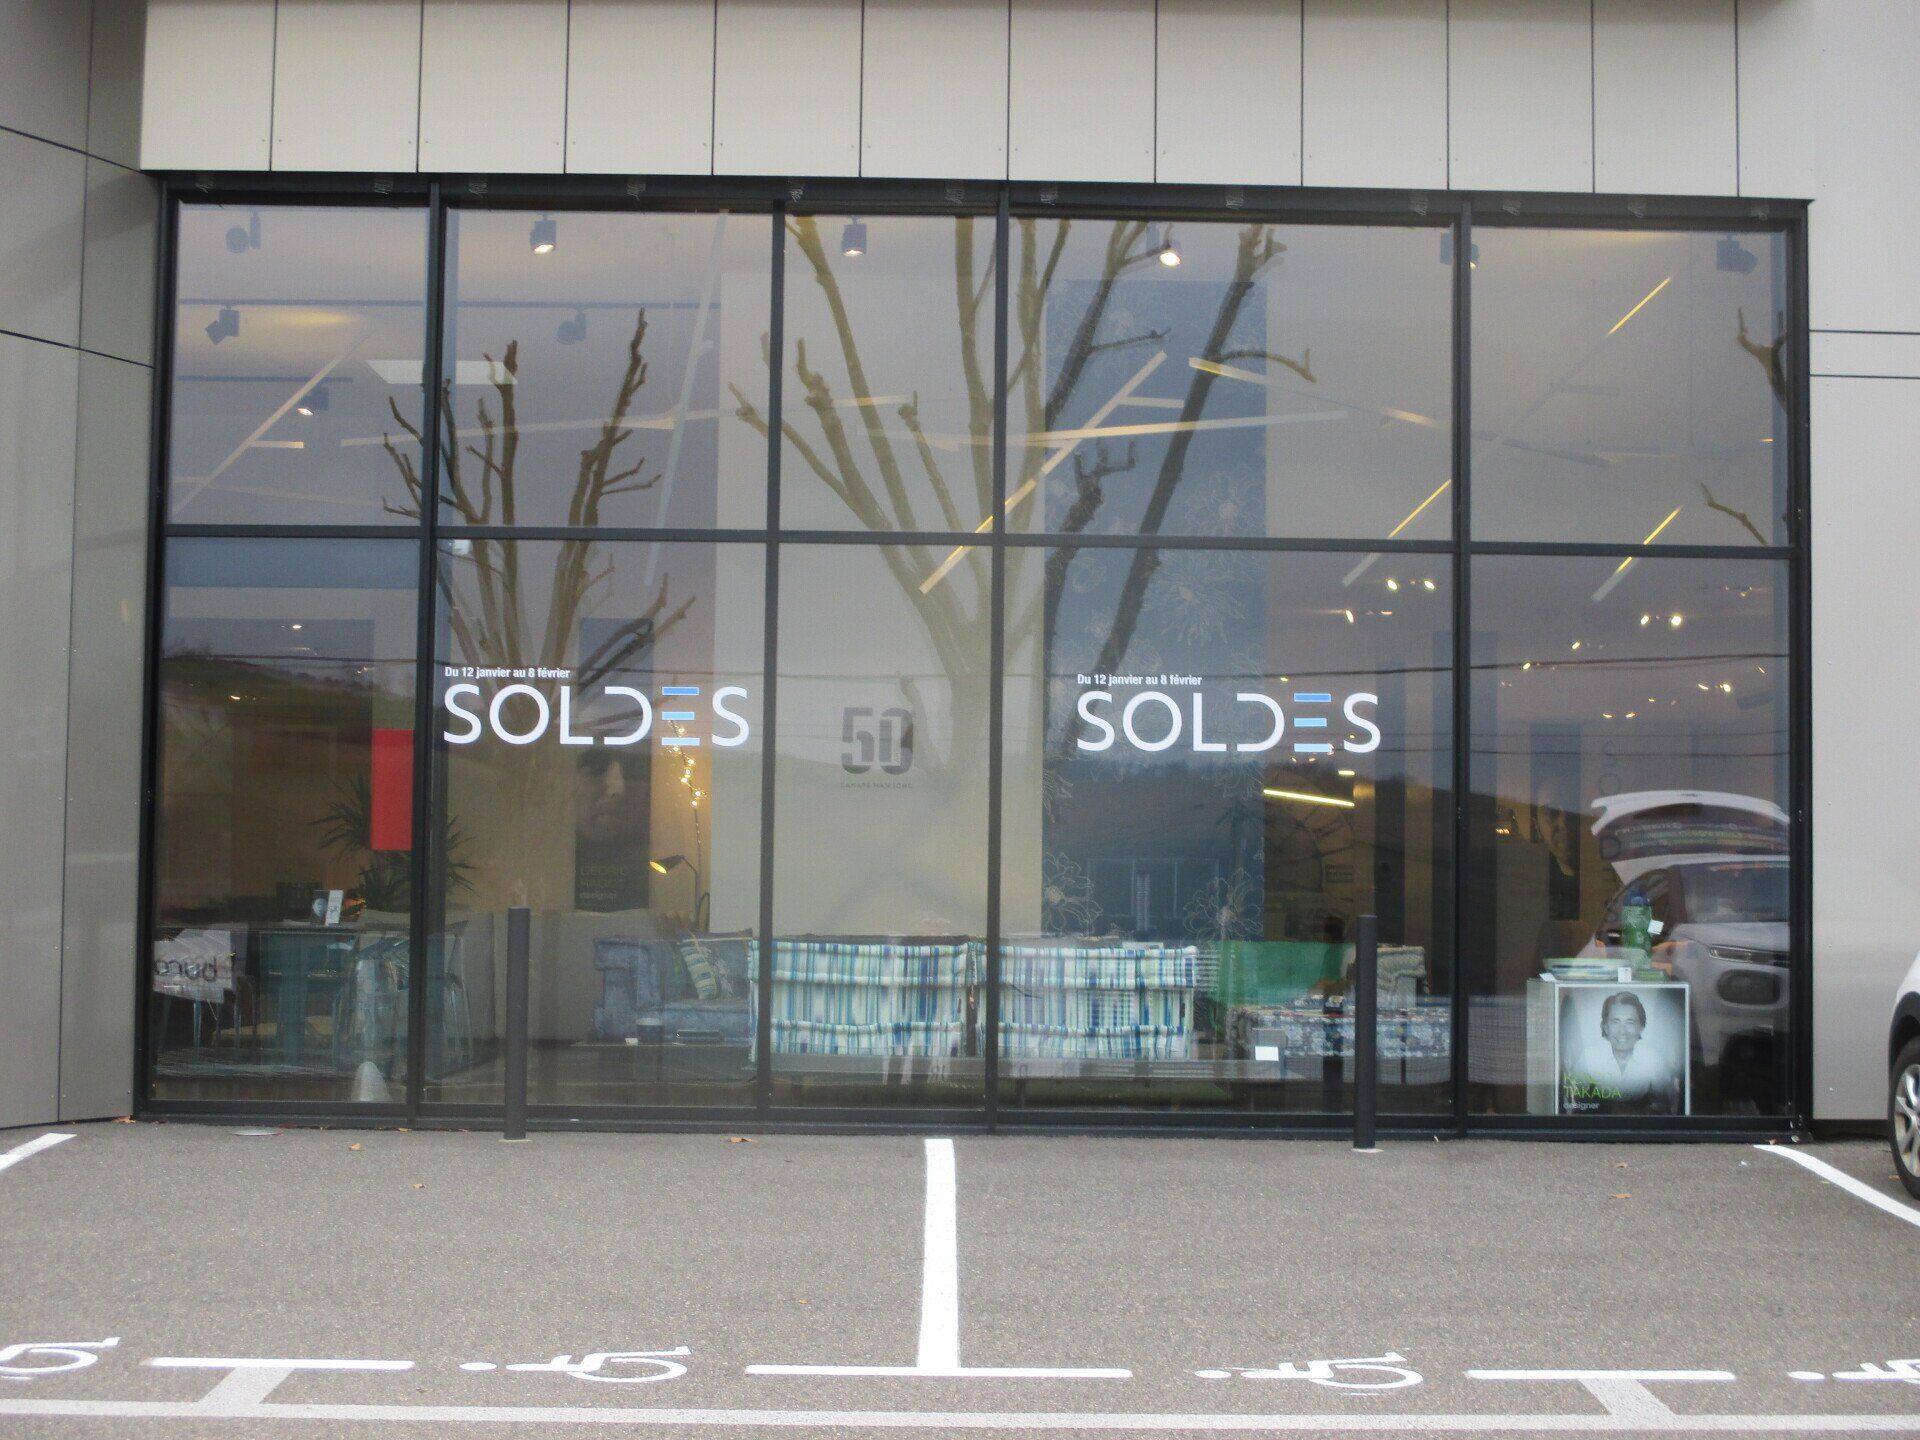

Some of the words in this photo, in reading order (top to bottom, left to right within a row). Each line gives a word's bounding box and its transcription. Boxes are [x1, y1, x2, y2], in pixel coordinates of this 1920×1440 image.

[445, 667, 459, 677] Du
[461, 667, 474, 677] 12
[475, 667, 512, 679] janvier
[513, 669, 526, 678] au
[528, 668, 536, 678] 8
[537, 668, 571, 678] février
[1077, 674, 1092, 684] Du
[1094, 674, 1106, 684] 12
[1107, 674, 1144, 687] janvier
[1145, 676, 1158, 685] au
[1160, 675, 1168, 685] 8
[1169, 675, 1203, 685] février
[443, 683, 750, 747] SOLDES
[1076, 690, 1382, 753] SOLDES
[1563, 1085, 1622, 1099] TAKADA
